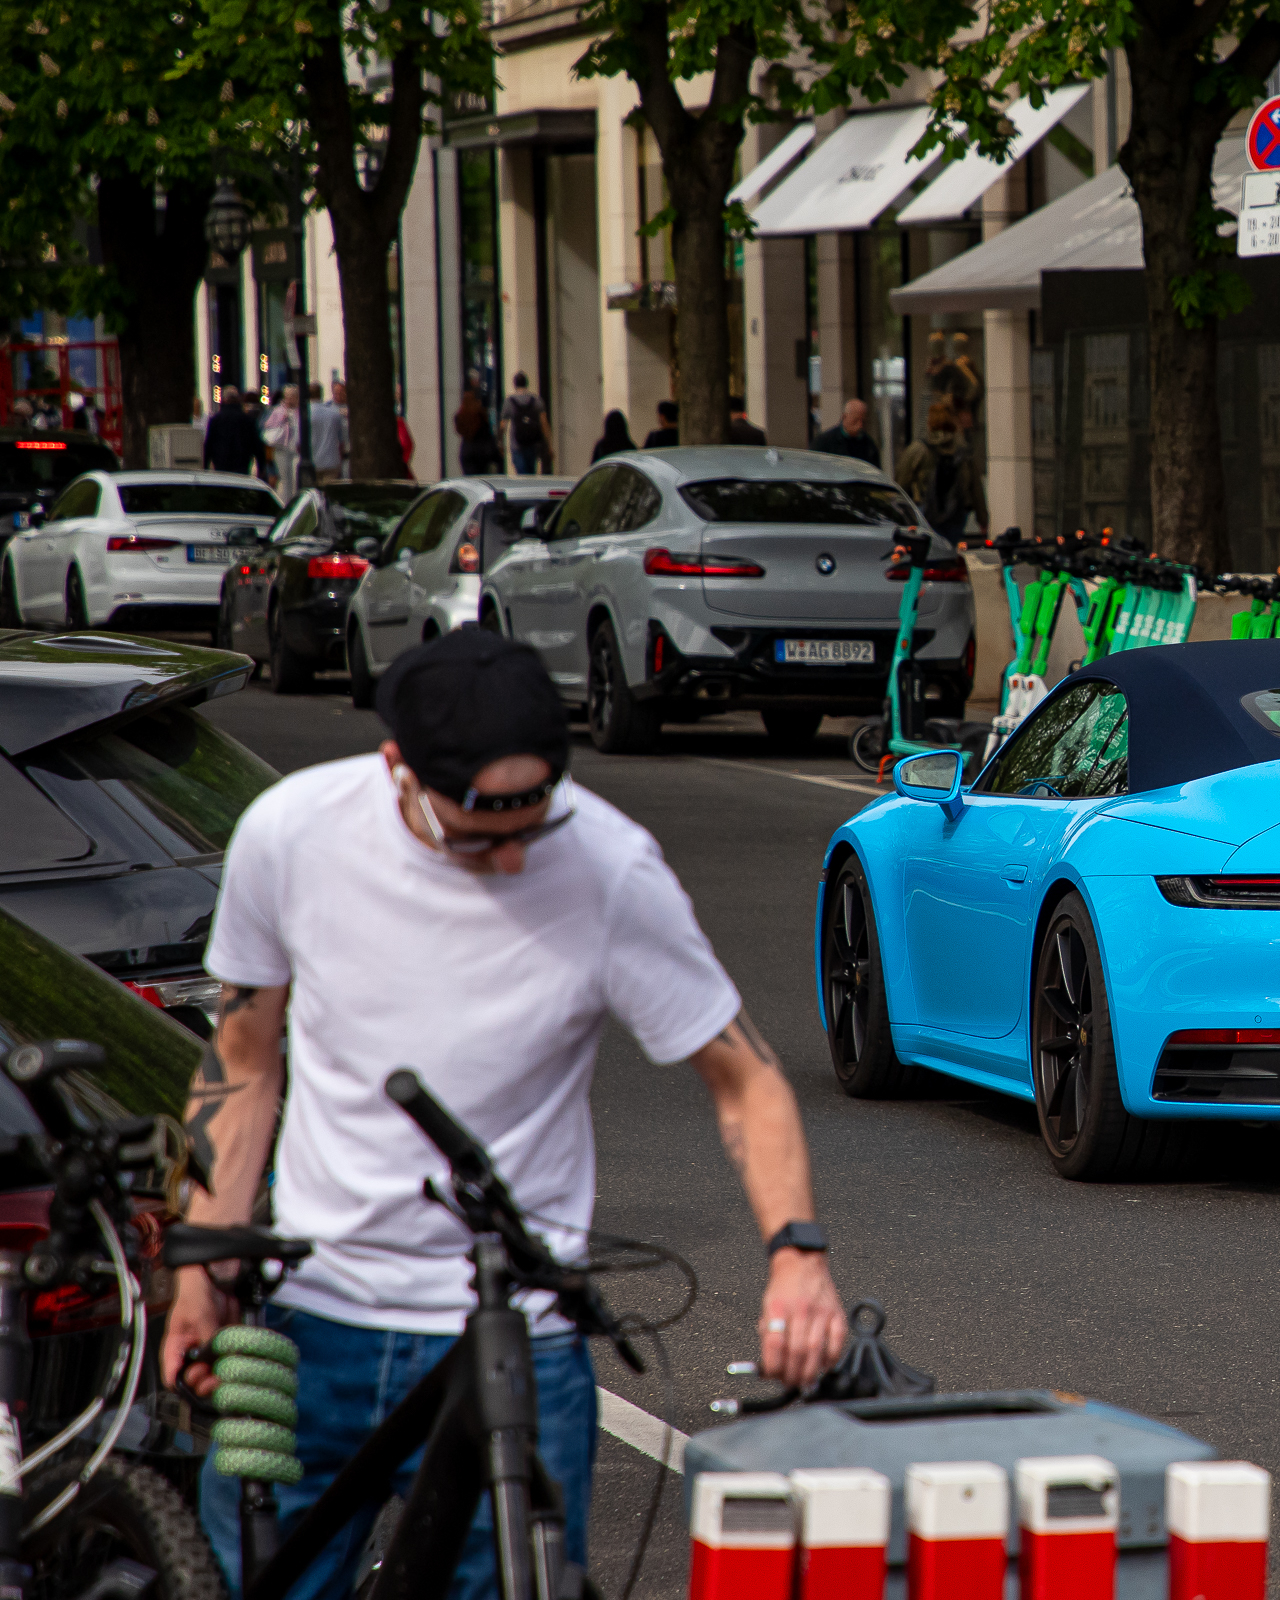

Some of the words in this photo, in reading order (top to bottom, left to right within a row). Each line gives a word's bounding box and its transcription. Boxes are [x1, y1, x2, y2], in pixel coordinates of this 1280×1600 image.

[1268, 232, 1280, 246] 20
[787, 641, 797, 657] W
[809, 641, 830, 659] AG
[832, 641, 871, 659] 8892
